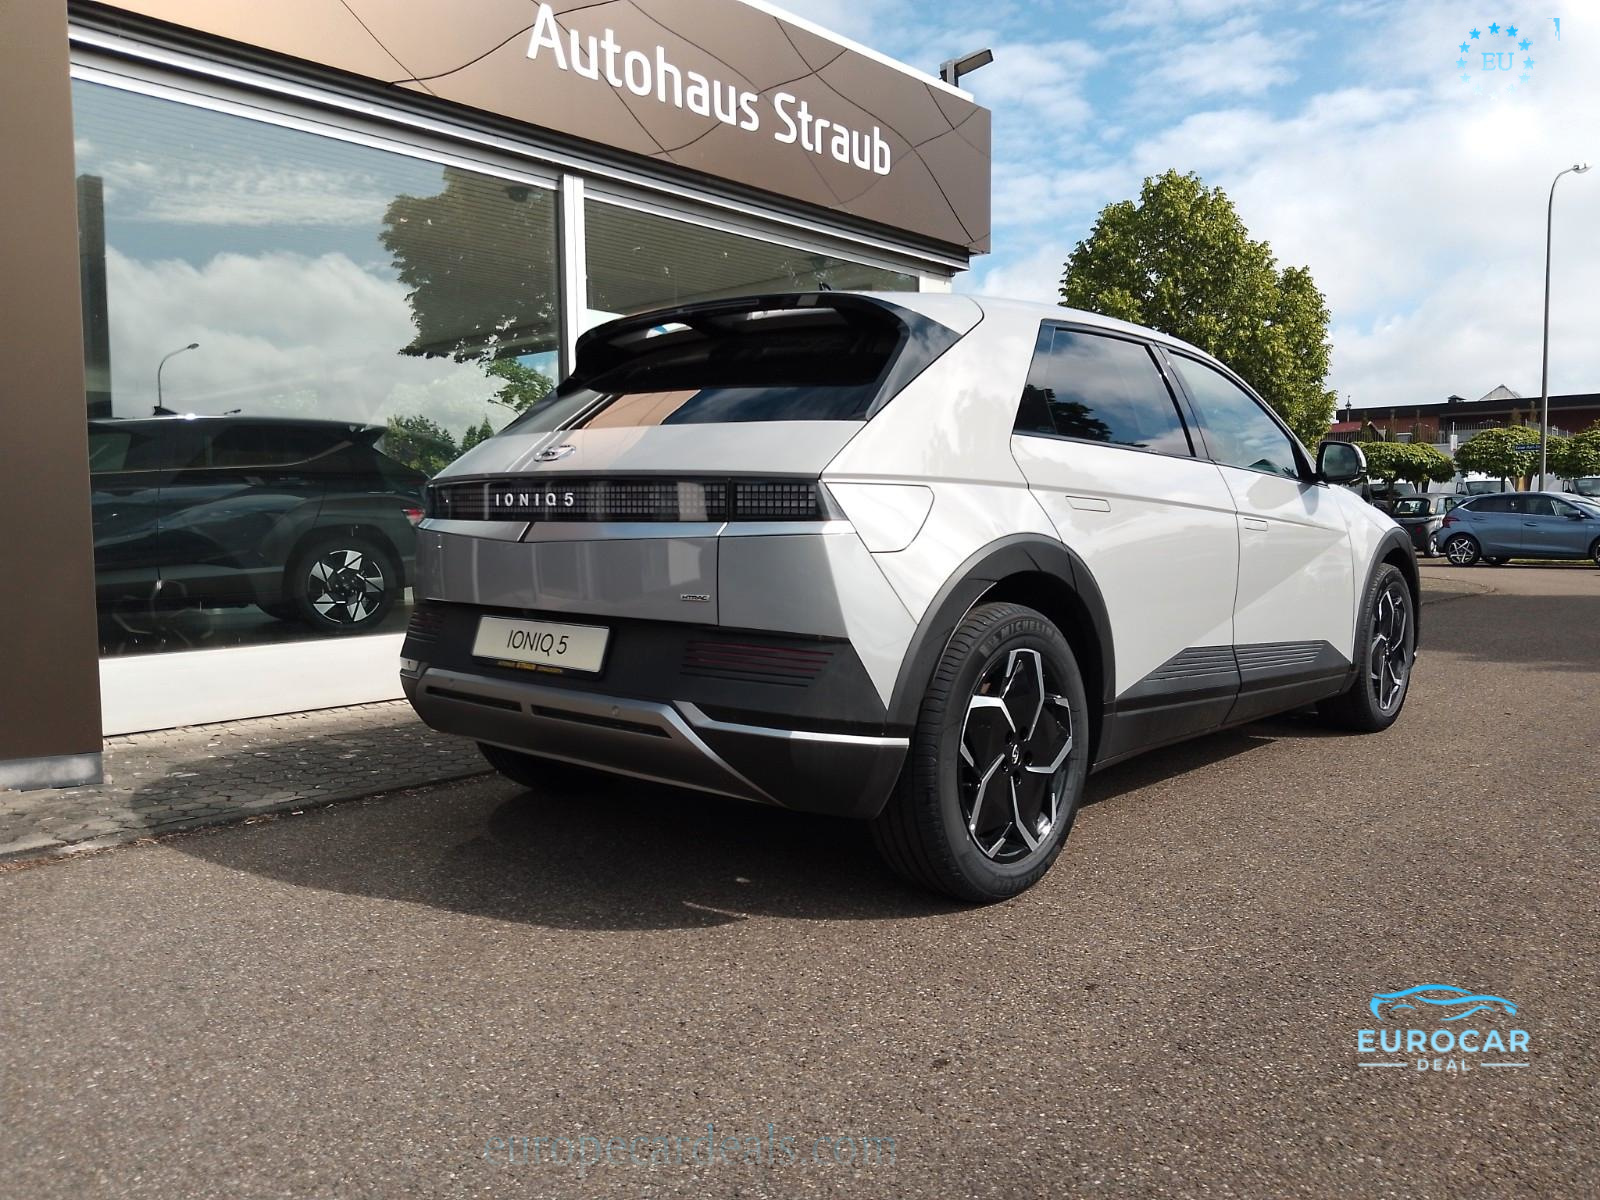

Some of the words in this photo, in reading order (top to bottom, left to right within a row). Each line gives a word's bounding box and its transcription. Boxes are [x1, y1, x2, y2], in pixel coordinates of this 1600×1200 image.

[526, 2, 760, 132] Autohaus
[774, 92, 892, 176] Straub
[495, 492, 557, 507] IONIQ
[564, 492, 574, 507] 5
[506, 629, 555, 657] IONIQ
[556, 635, 569, 655] 5
